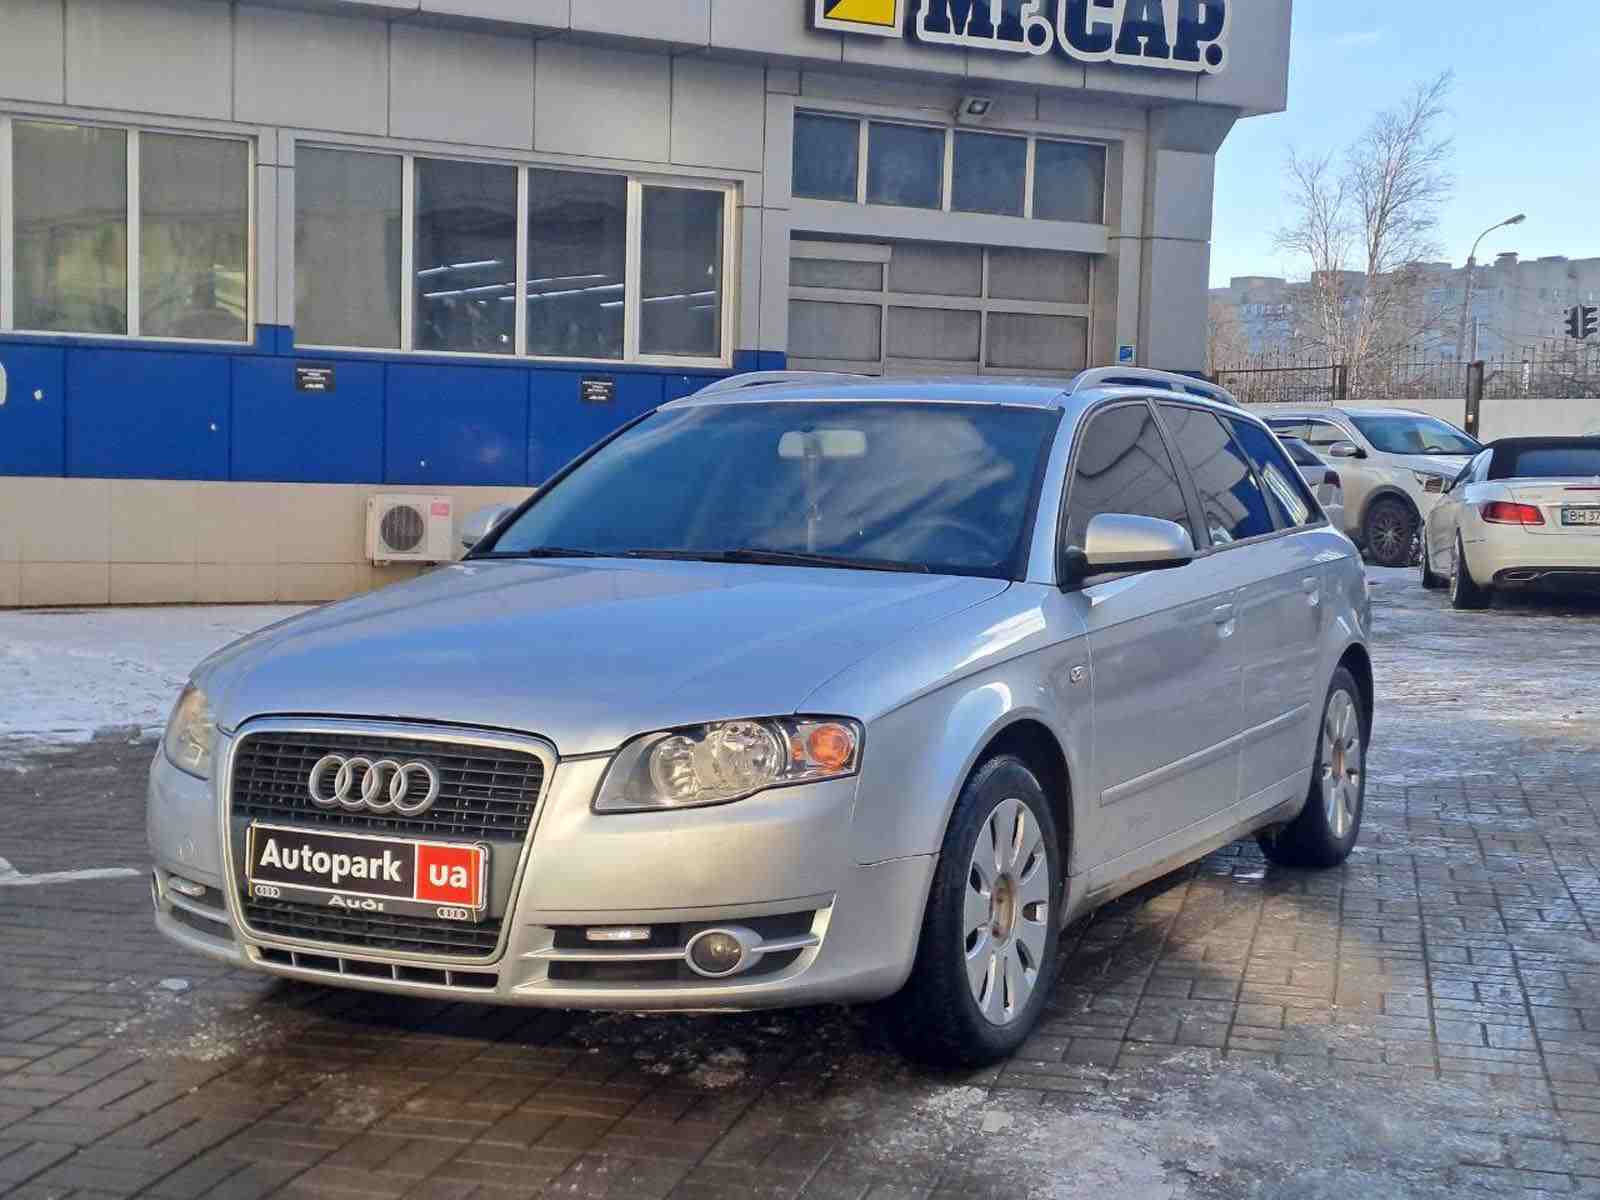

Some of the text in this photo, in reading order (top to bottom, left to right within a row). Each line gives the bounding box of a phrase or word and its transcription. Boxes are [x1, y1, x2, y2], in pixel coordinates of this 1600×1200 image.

[259, 838, 468, 888] Autopark ua
[327, 895, 384, 911] Audi
